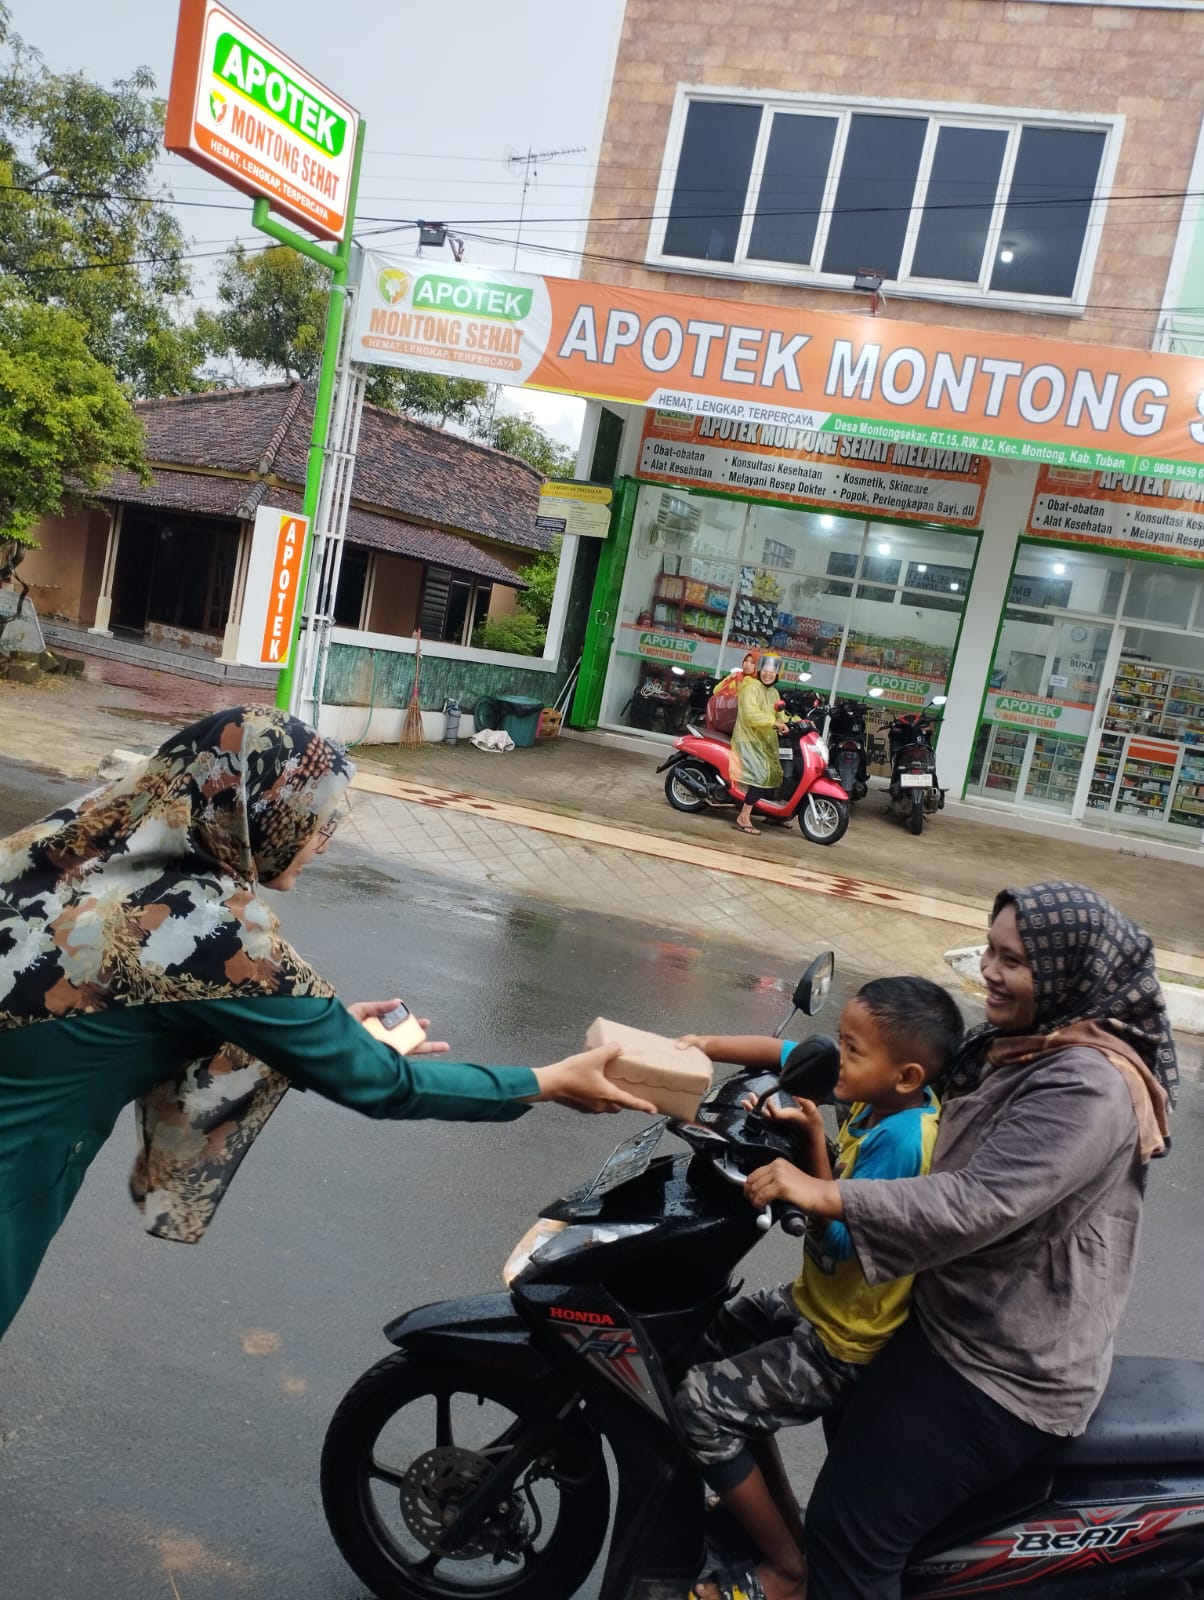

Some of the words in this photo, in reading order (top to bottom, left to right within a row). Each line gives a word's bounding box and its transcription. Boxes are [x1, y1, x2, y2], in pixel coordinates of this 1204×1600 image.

[221, 43, 337, 152] APOTEK
[231, 104, 299, 174] MONTONG
[301, 154, 340, 200] SEHAT
[210, 139, 241, 168] HEMAT,
[243, 158, 282, 192] LENGKAP,
[283, 183, 328, 220] TERPERCAYA
[416, 280, 525, 316] APOTEK
[369, 308, 462, 345] MONTONG
[466, 322, 524, 355] SEHAT
[453, 350, 514, 369] TERPERCAYA
[557, 304, 814, 392] APOTEK
[824, 339, 1171, 437] MONTONG
[658, 394, 694, 411] HEMAT,
[697, 400, 745, 418] LENGKAP,
[748, 407, 814, 427] TERPERCAYA
[699, 415, 760, 444] APOTEK
[840, 435, 889, 464] SEHAT
[891, 443, 973, 475] MELAYANI
[834, 419, 857, 432] Desa
[859, 421, 928, 442] Montongsekar,
[961, 436, 979, 449] RW.
[982, 439, 996, 452] 02,
[998, 441, 1019, 456] Kec.
[1021, 446, 1066, 463] Montong,
[1070, 450, 1092, 465] Kab.
[1095, 453, 1125, 469] Tuban
[650, 458, 667, 471] Alat
[669, 461, 713, 479] Kesehatan
[728, 471, 767, 488] Melayani
[769, 477, 796, 493] Resep
[798, 482, 826, 496] Dokter
[840, 488, 869, 504] Popok,
[872, 493, 934, 513] Perlengkapan
[936, 500, 959, 516] Bayi,
[962, 505, 975, 517] dll
[653, 444, 705, 462] Obat-obatan
[731, 456, 775, 472] Konsultasi
[777, 463, 823, 480] Kesehatan
[843, 472, 886, 490] Kosmetik,
[889, 479, 929, 495] Skincare
[1098, 471, 1165, 497] APOTEK
[1047, 499, 1105, 516] Obat-obatan
[1134, 510, 1184, 527] Konsultasi
[1043, 515, 1063, 527] Alat
[1065, 517, 1113, 534] Kesehatan
[1130, 526, 1174, 543] Melayani
[1176, 533, 1204, 549] Resep
[269, 522, 296, 660] APOTEK
[643, 635, 692, 651] APOTEK
[1070, 660, 1093, 670] BUKA
[871, 675, 926, 693] APOTEK
[1000, 698, 1056, 717] APOTEK
[549, 1307, 615, 1325] HONDA
